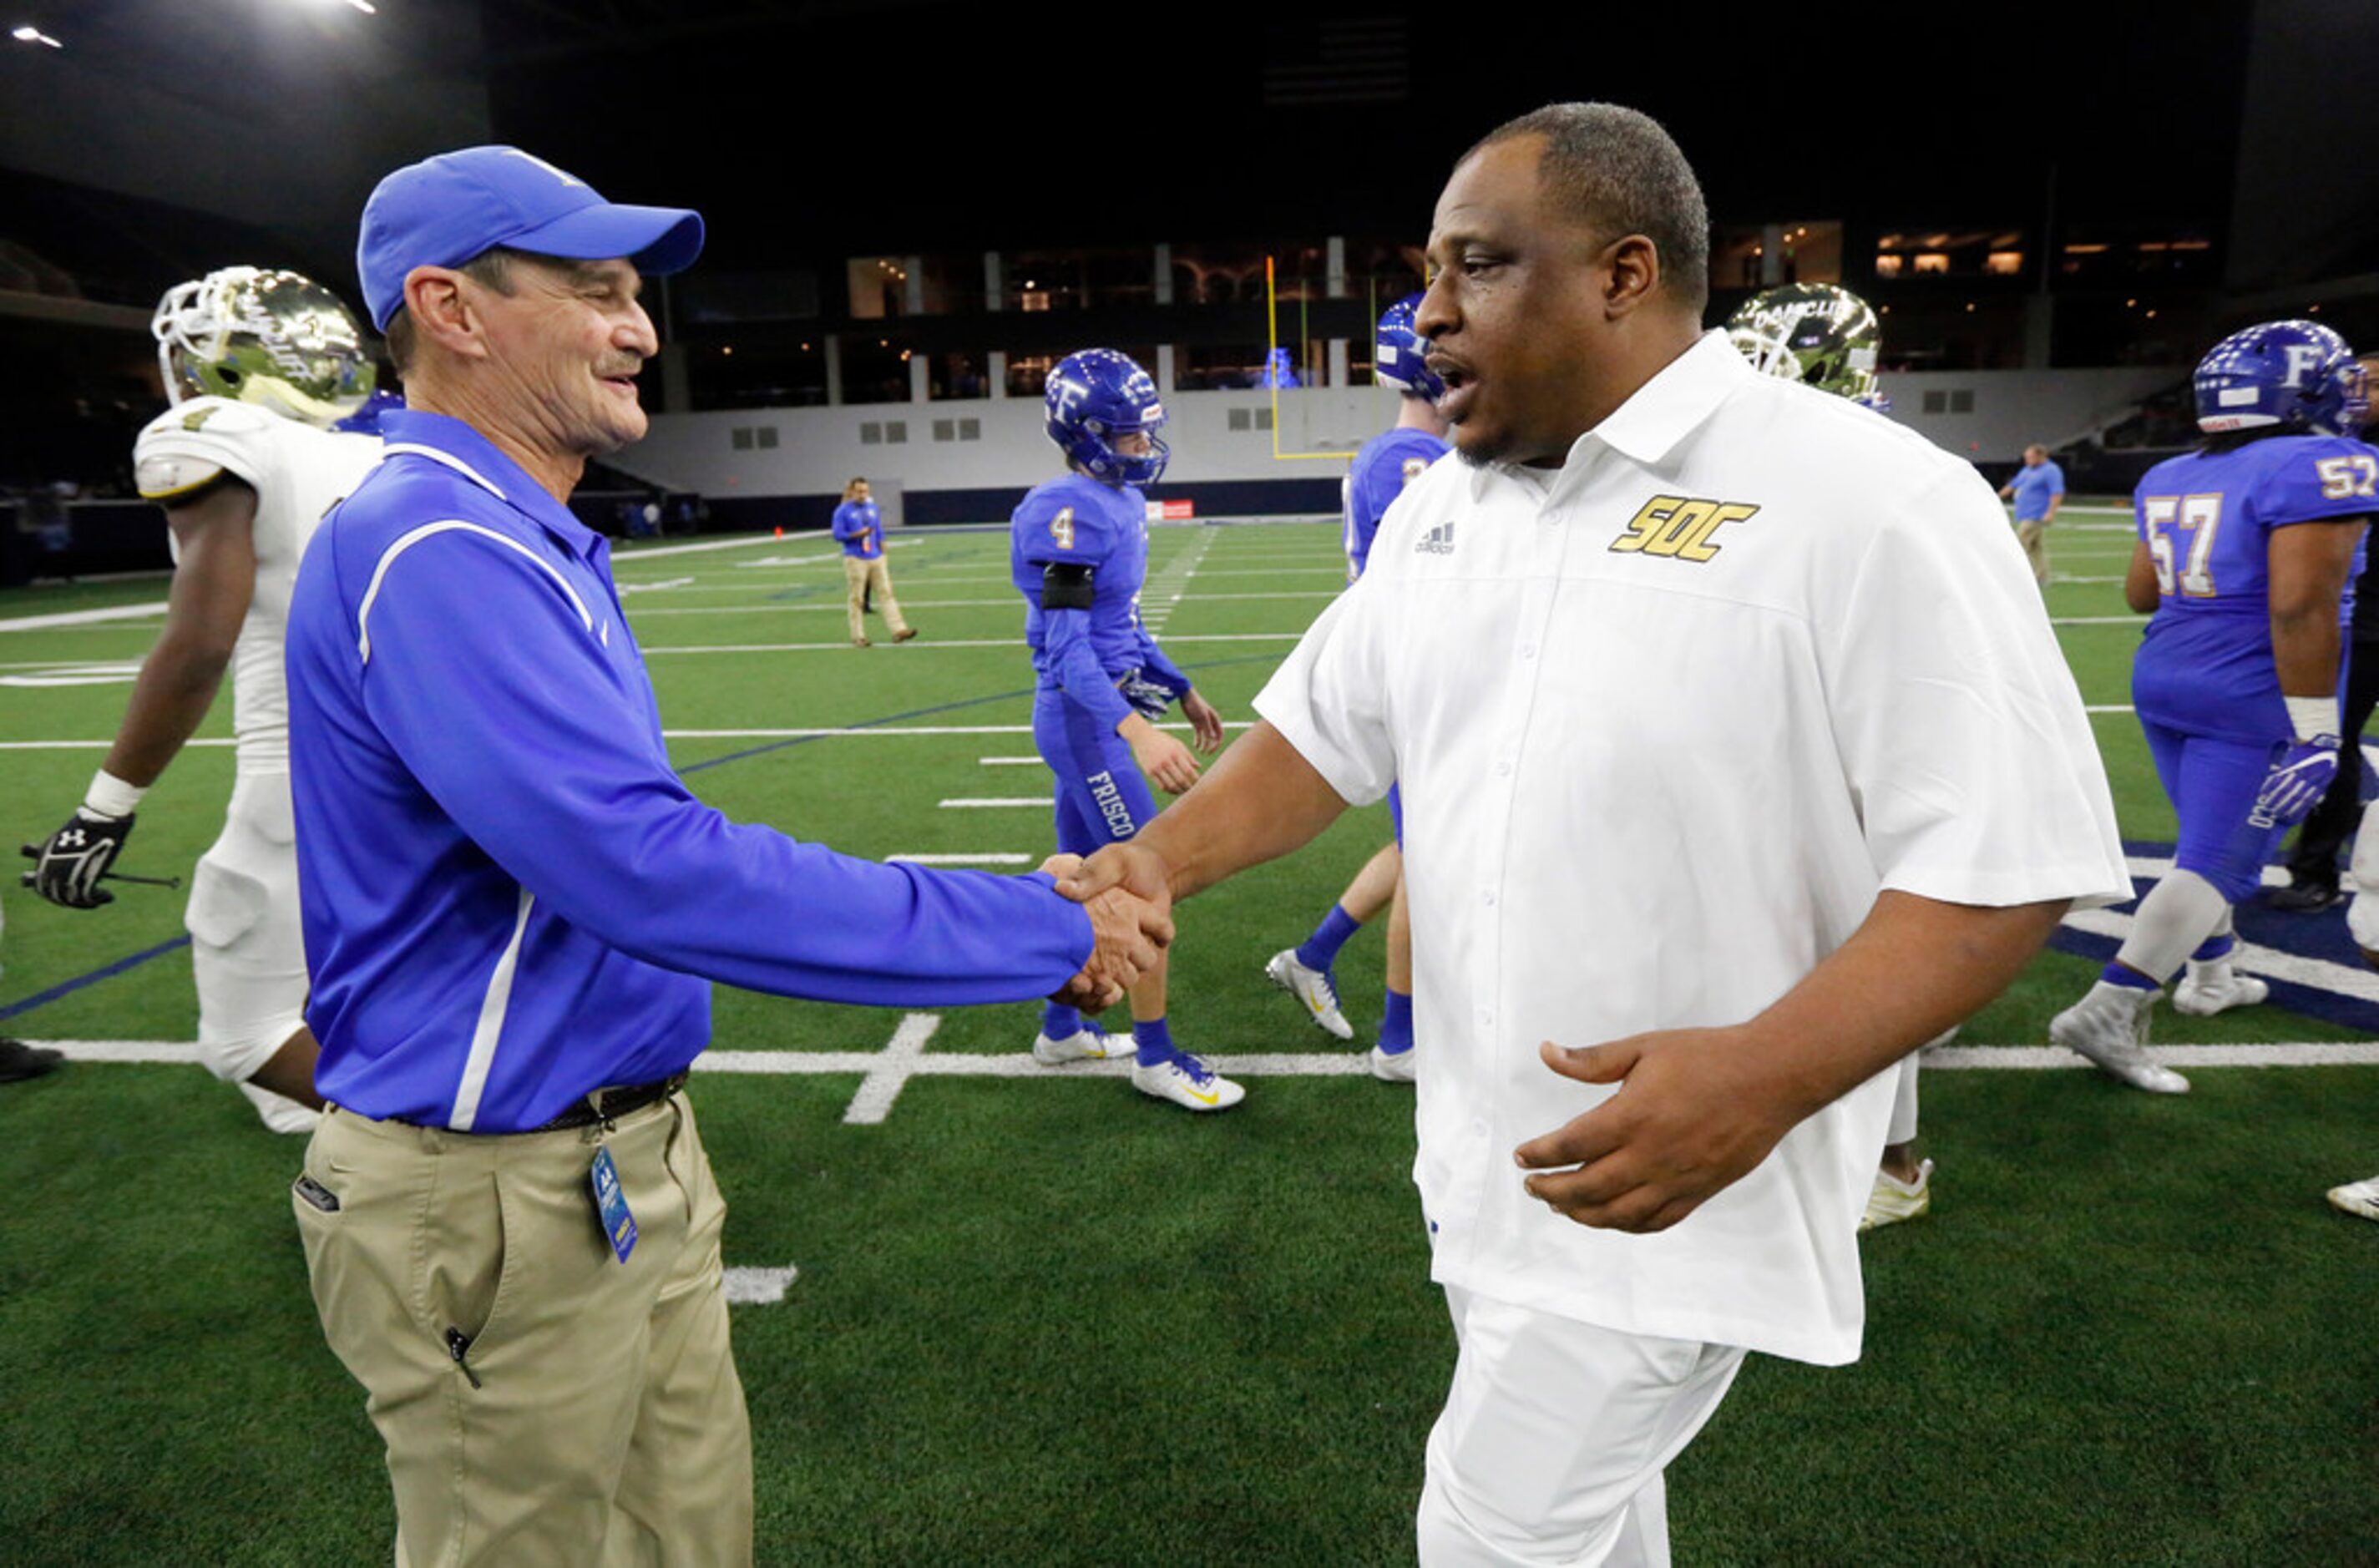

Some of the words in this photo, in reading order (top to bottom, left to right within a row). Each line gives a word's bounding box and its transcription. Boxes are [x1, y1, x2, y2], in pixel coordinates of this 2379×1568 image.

[2280, 344, 2326, 388] F
[1054, 377, 1089, 424] F
[2315, 454, 2378, 501] 57
[1049, 506, 1076, 550] 4
[2144, 492, 2224, 598] 57
[1086, 770, 1136, 837] FRISCO
